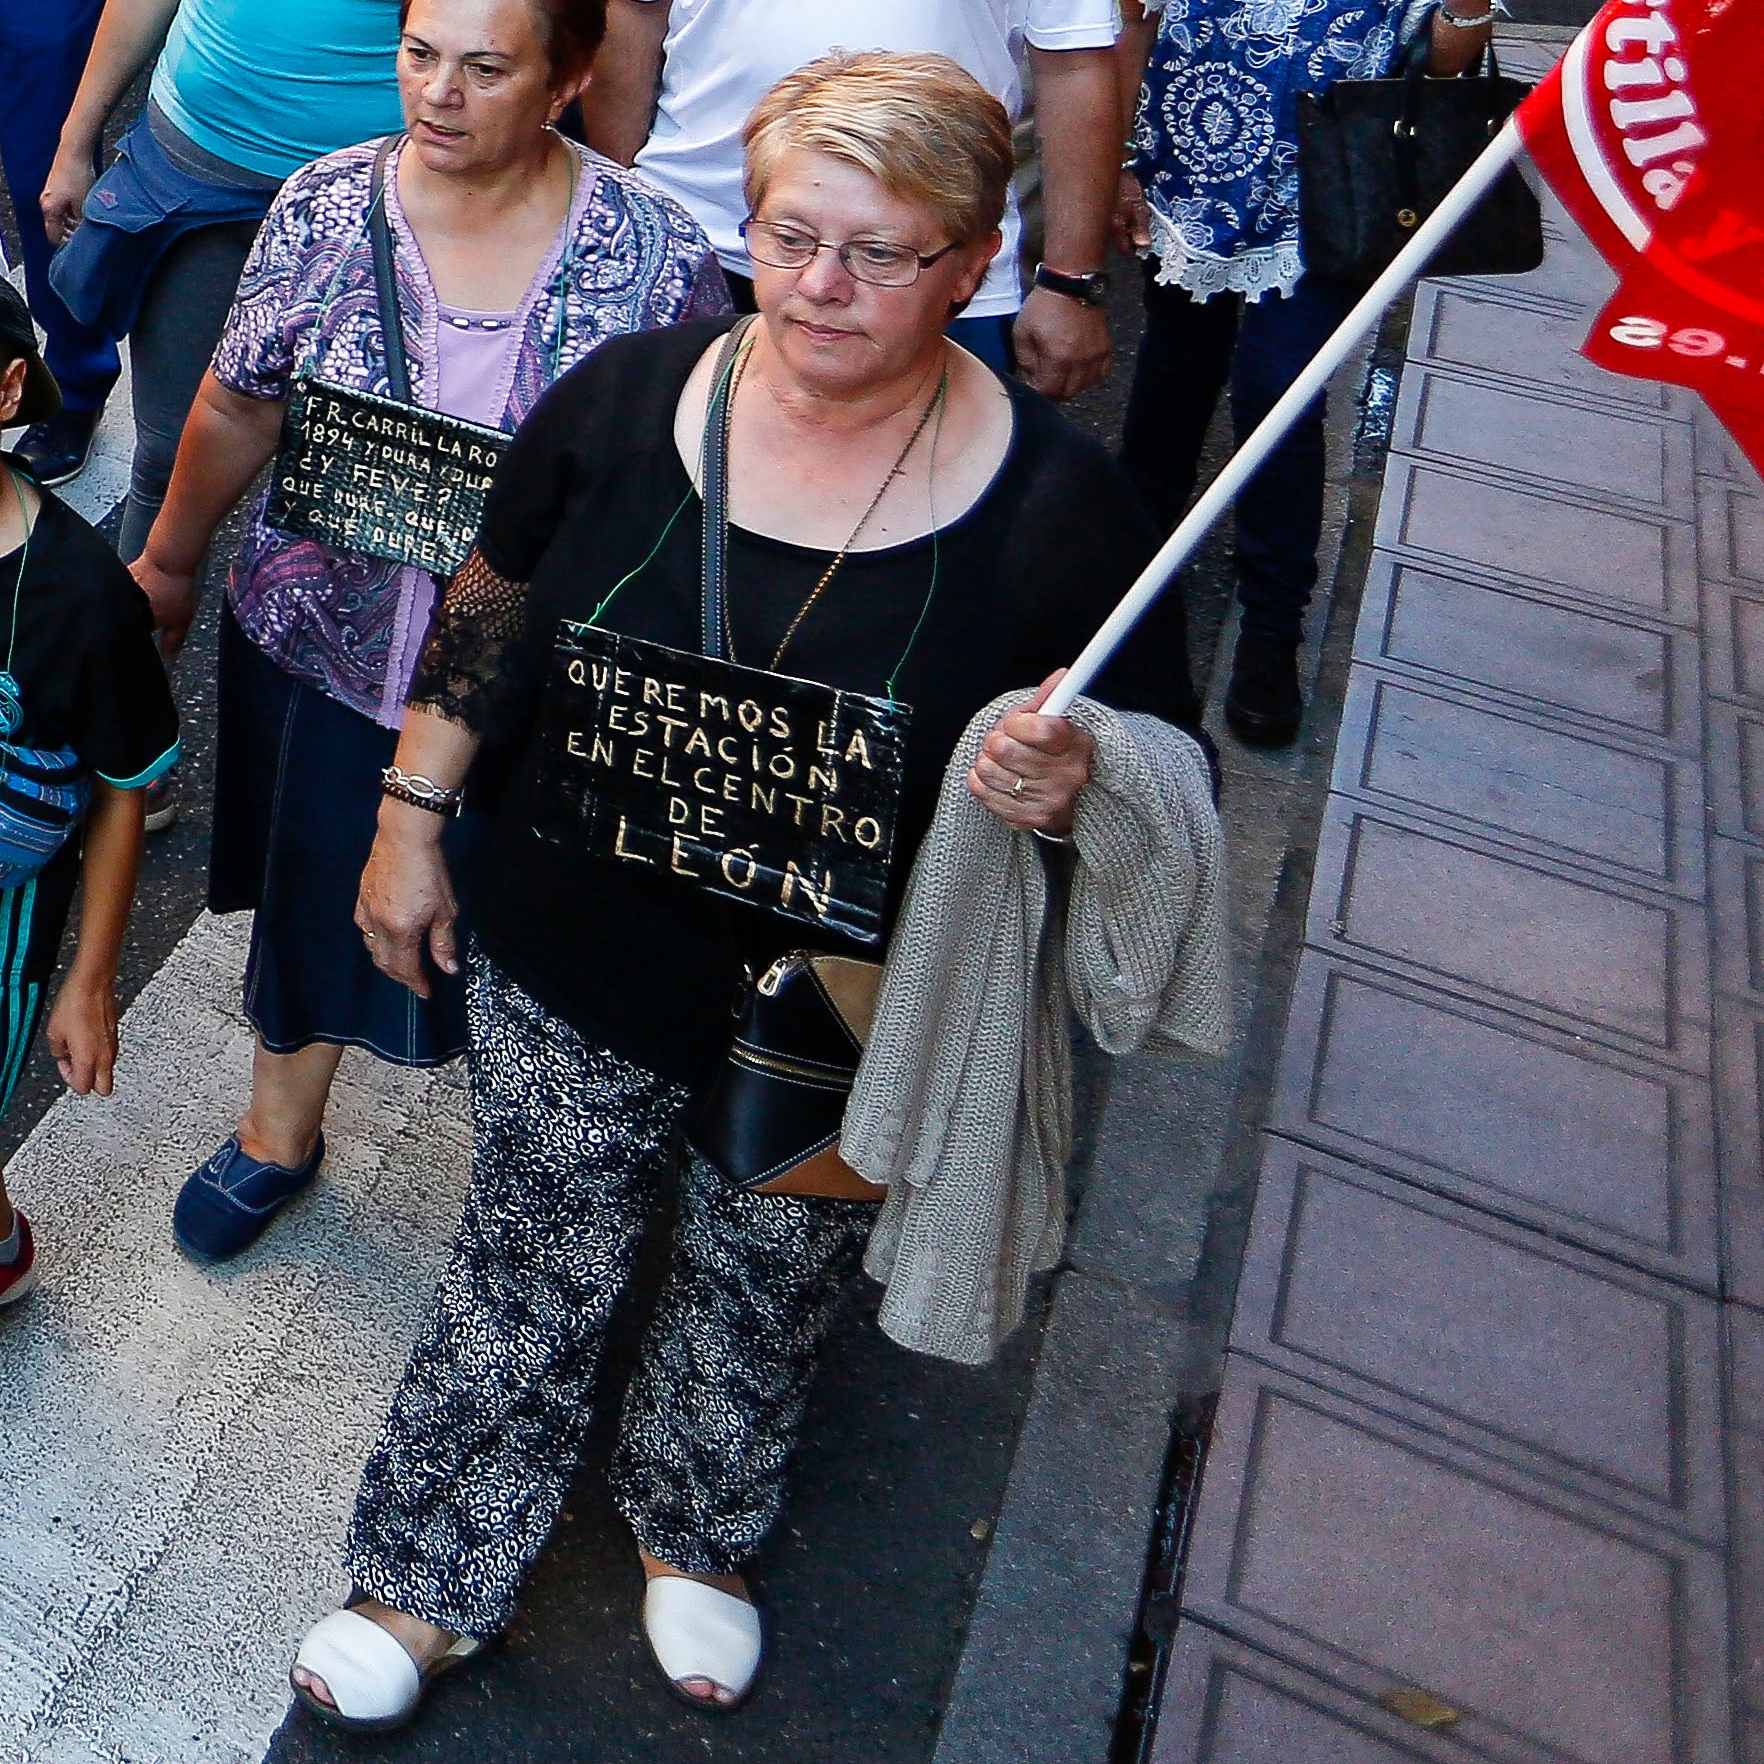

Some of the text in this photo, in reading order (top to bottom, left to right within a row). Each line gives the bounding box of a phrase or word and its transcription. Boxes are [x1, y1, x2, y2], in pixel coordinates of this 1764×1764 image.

[281, 476, 324, 499] QUE
[300, 419, 354, 452] 1894
[381, 444, 432, 474] DURA
[451, 467, 495, 492] DUR
[437, 435, 463, 460] LA
[468, 445, 498, 468] RO
[307, 508, 358, 537] QUE
[567, 658, 872, 770] QUEREMOS LA
[608, 705, 838, 799] ESTACIÓN
[567, 730, 613, 768] EN
[694, 767, 881, 849] CENTRO
[668, 795, 727, 838] DE
[614, 815, 832, 919] LEÓN
